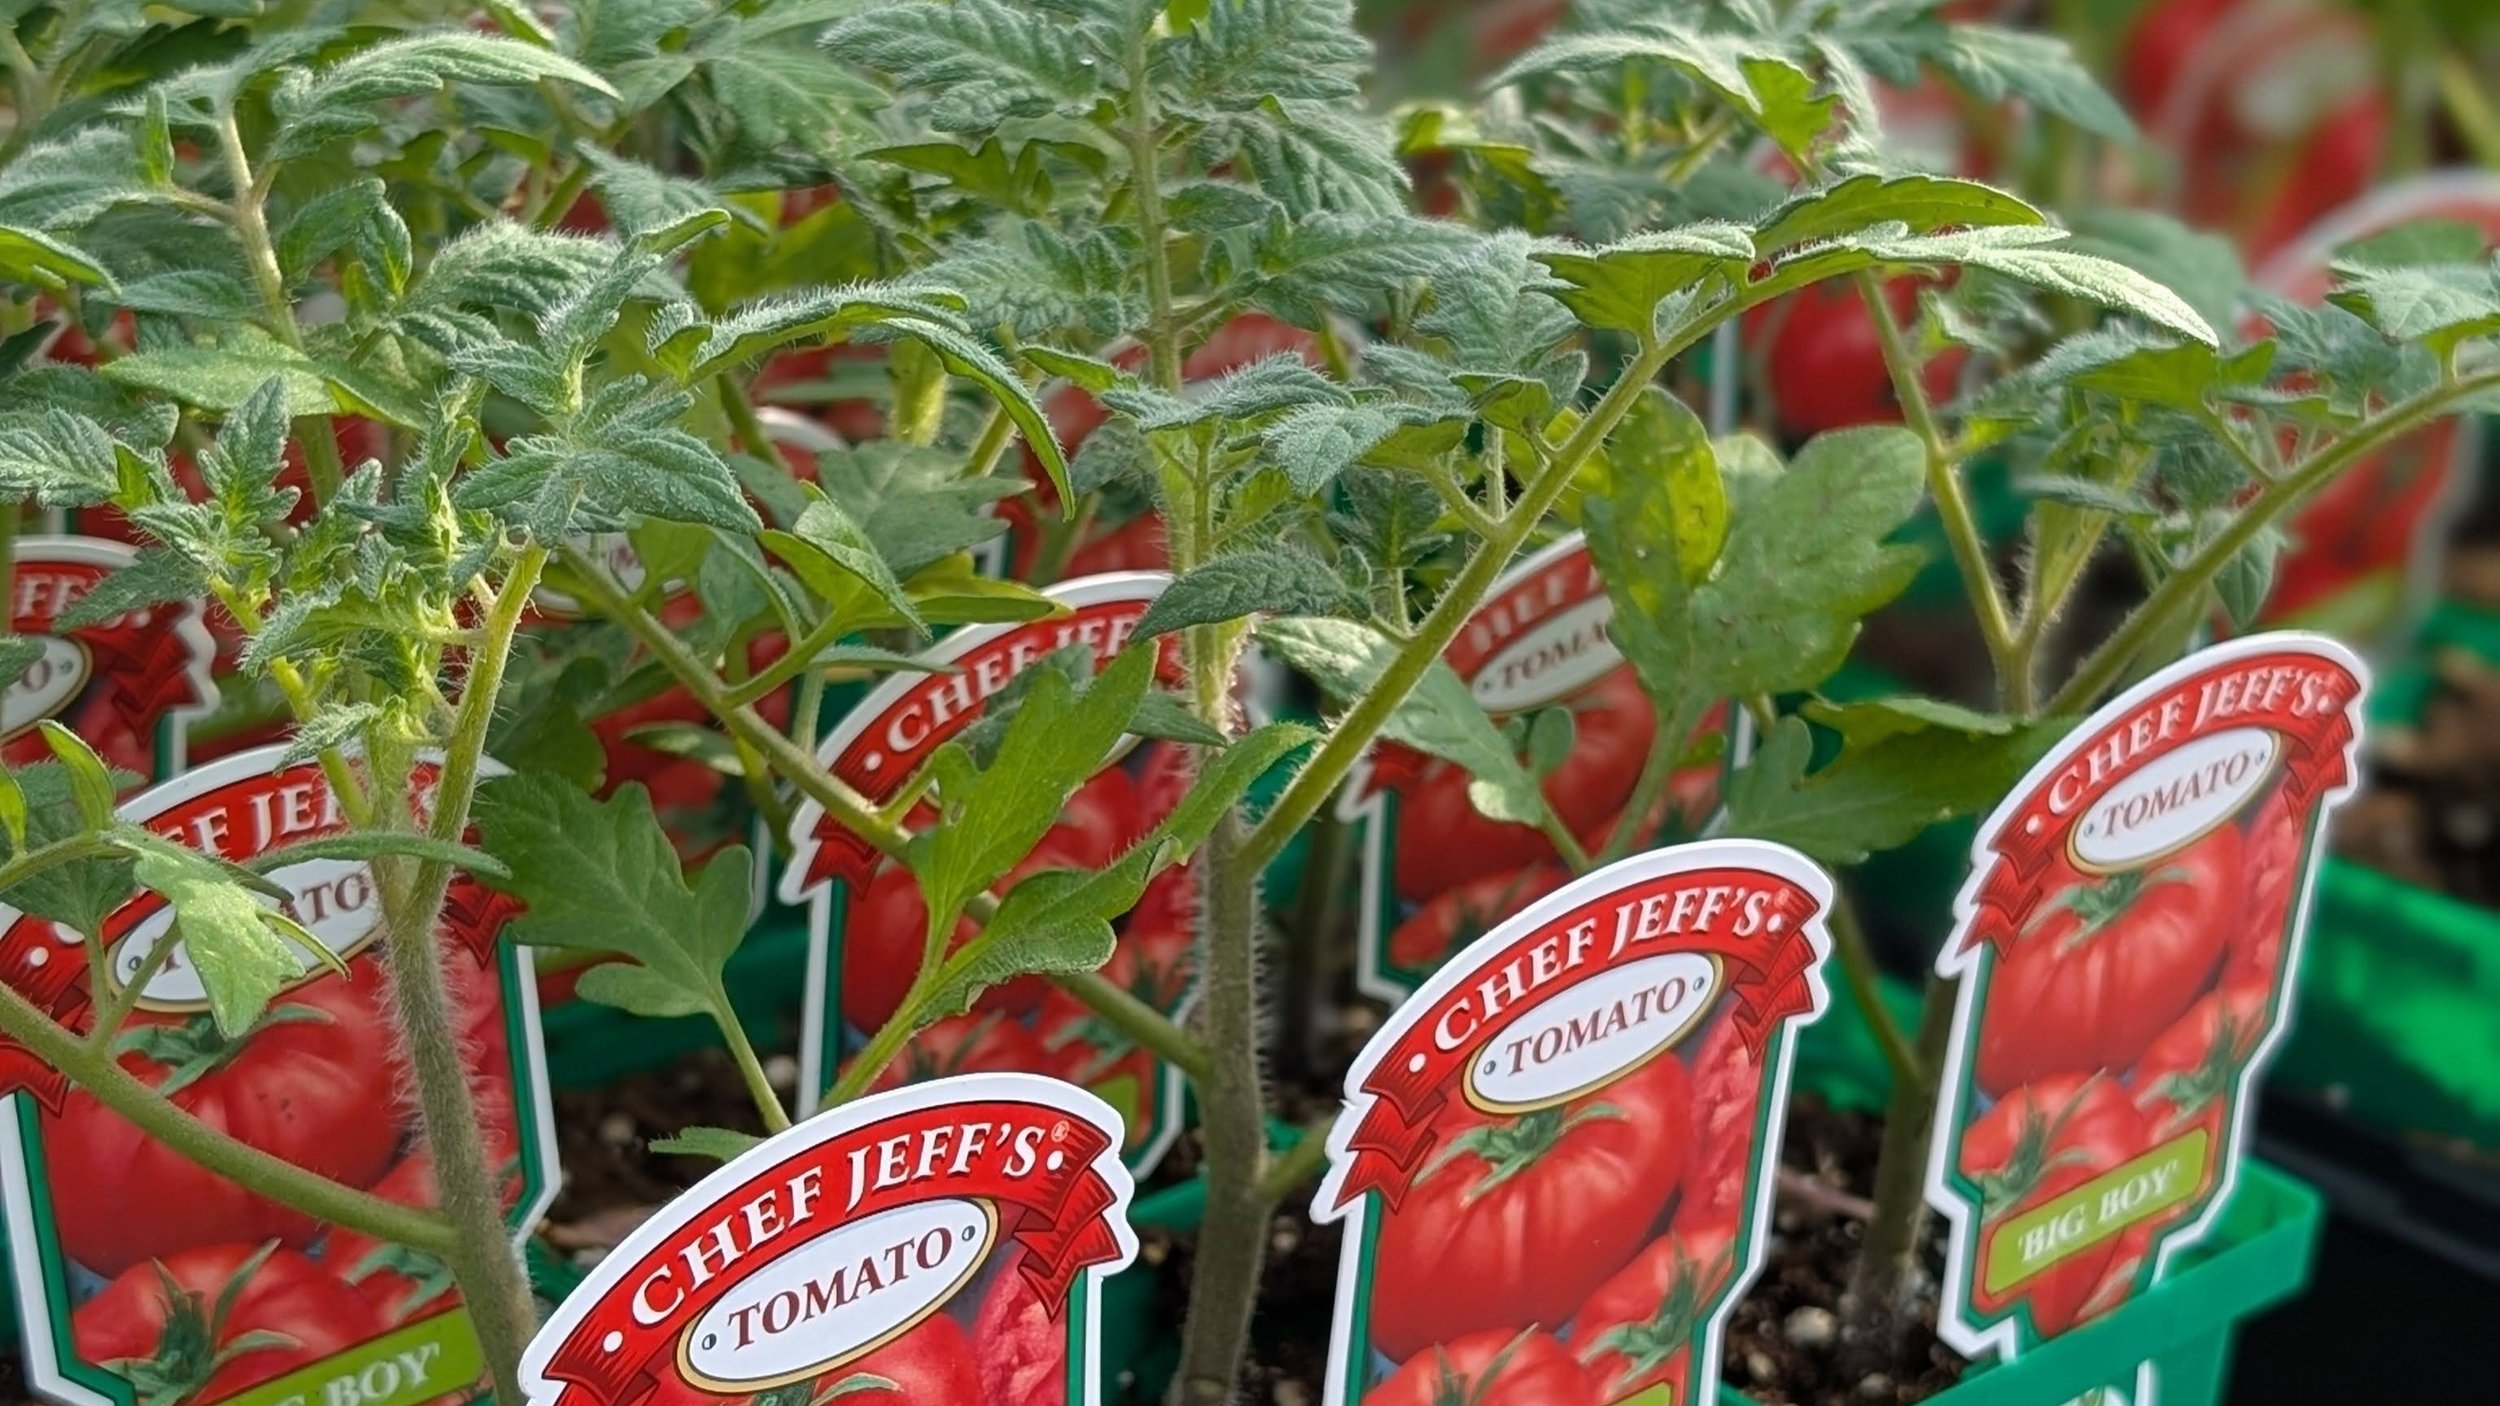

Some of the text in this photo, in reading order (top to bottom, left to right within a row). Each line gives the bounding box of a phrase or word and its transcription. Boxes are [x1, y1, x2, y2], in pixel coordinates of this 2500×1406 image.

[2048, 665, 2326, 816] CHEF JEFF'S
[2100, 750, 2251, 838] TOMATO
[1434, 885, 1773, 1052] CHEF JEFF'S
[1505, 977, 1686, 1077] TOMATO
[631, 1163, 824, 1327] CHEF
[727, 1226, 953, 1352] TOMATO
